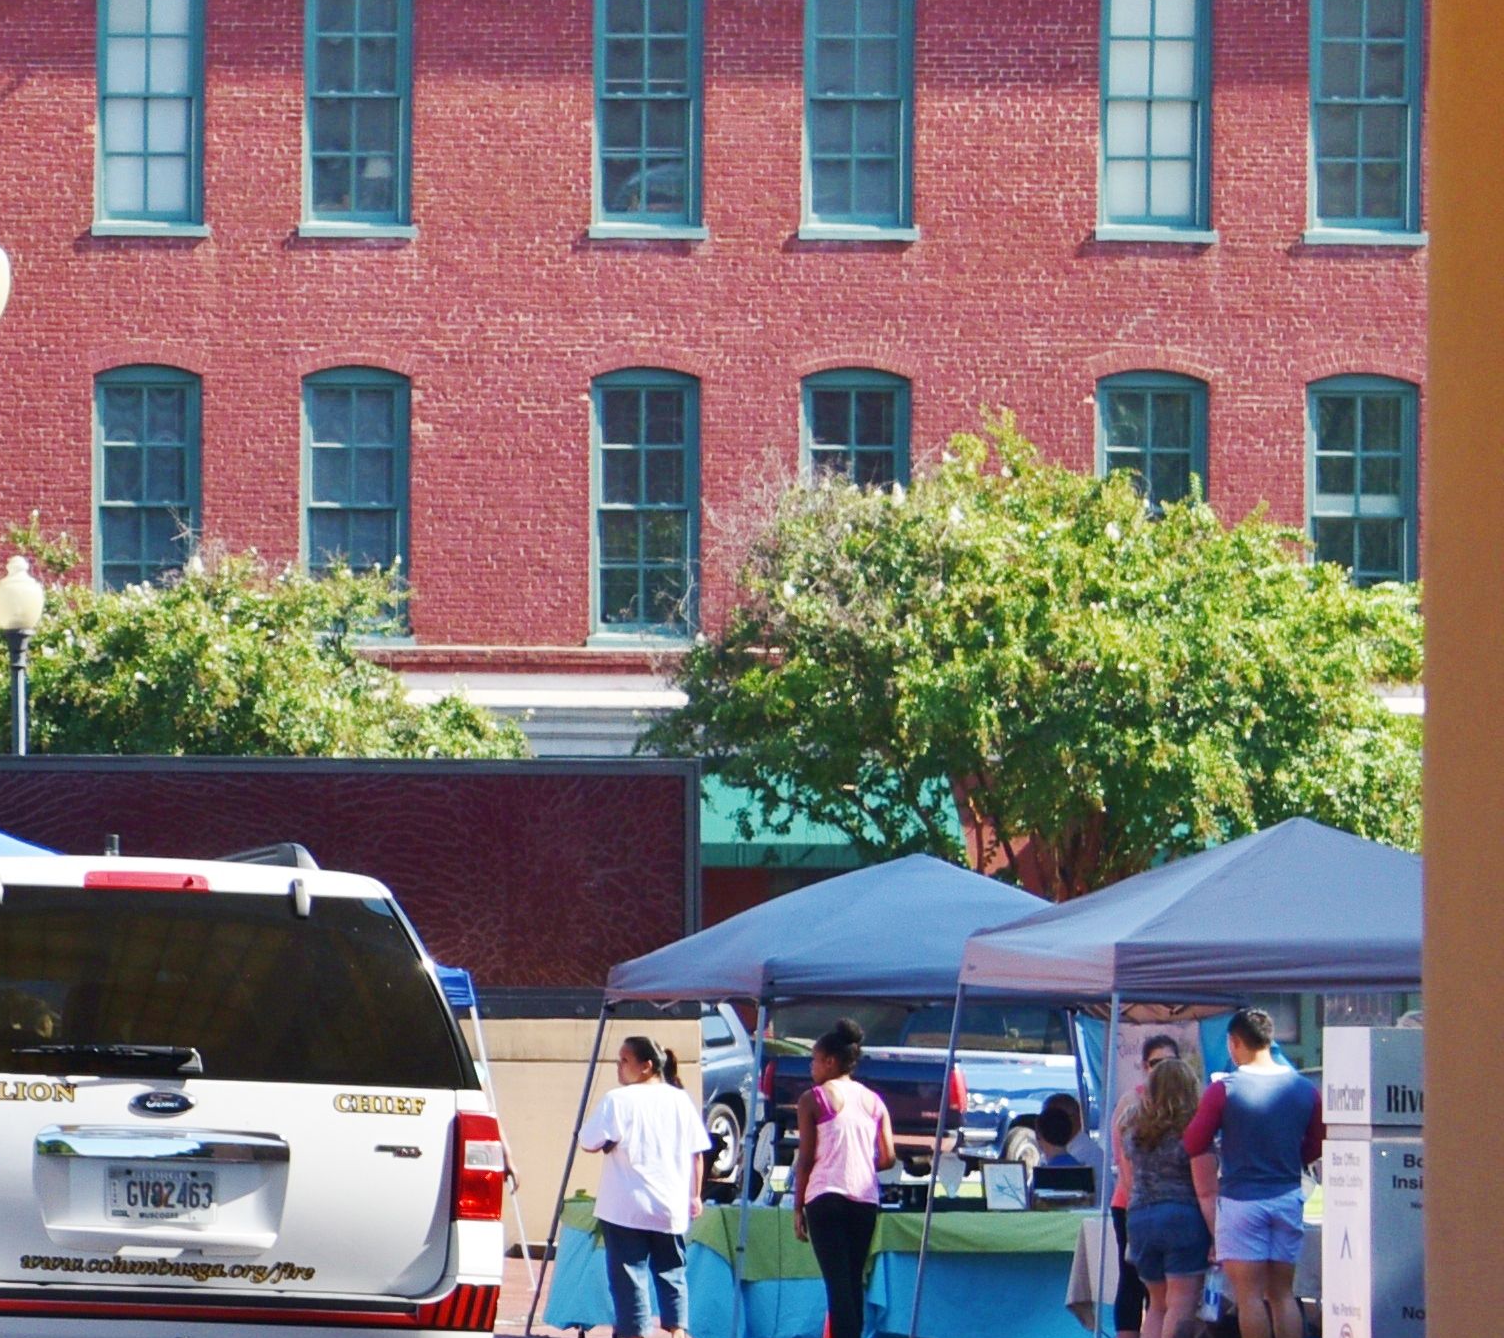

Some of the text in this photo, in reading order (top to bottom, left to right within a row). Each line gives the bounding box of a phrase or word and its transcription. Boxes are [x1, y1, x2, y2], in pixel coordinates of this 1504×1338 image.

[333, 1093, 426, 1115] CHIEF
[1386, 1085, 1424, 1113] Riv
[1333, 1153, 1360, 1166] Box Office
[1404, 1154, 1423, 1168] Bo
[1329, 1175, 1345, 1187] Inside
[1392, 1175, 1423, 1189] Insi
[127, 1181, 213, 1208] GV82463
[20, 1254, 315, 1284] www.columbusga.org/fire
